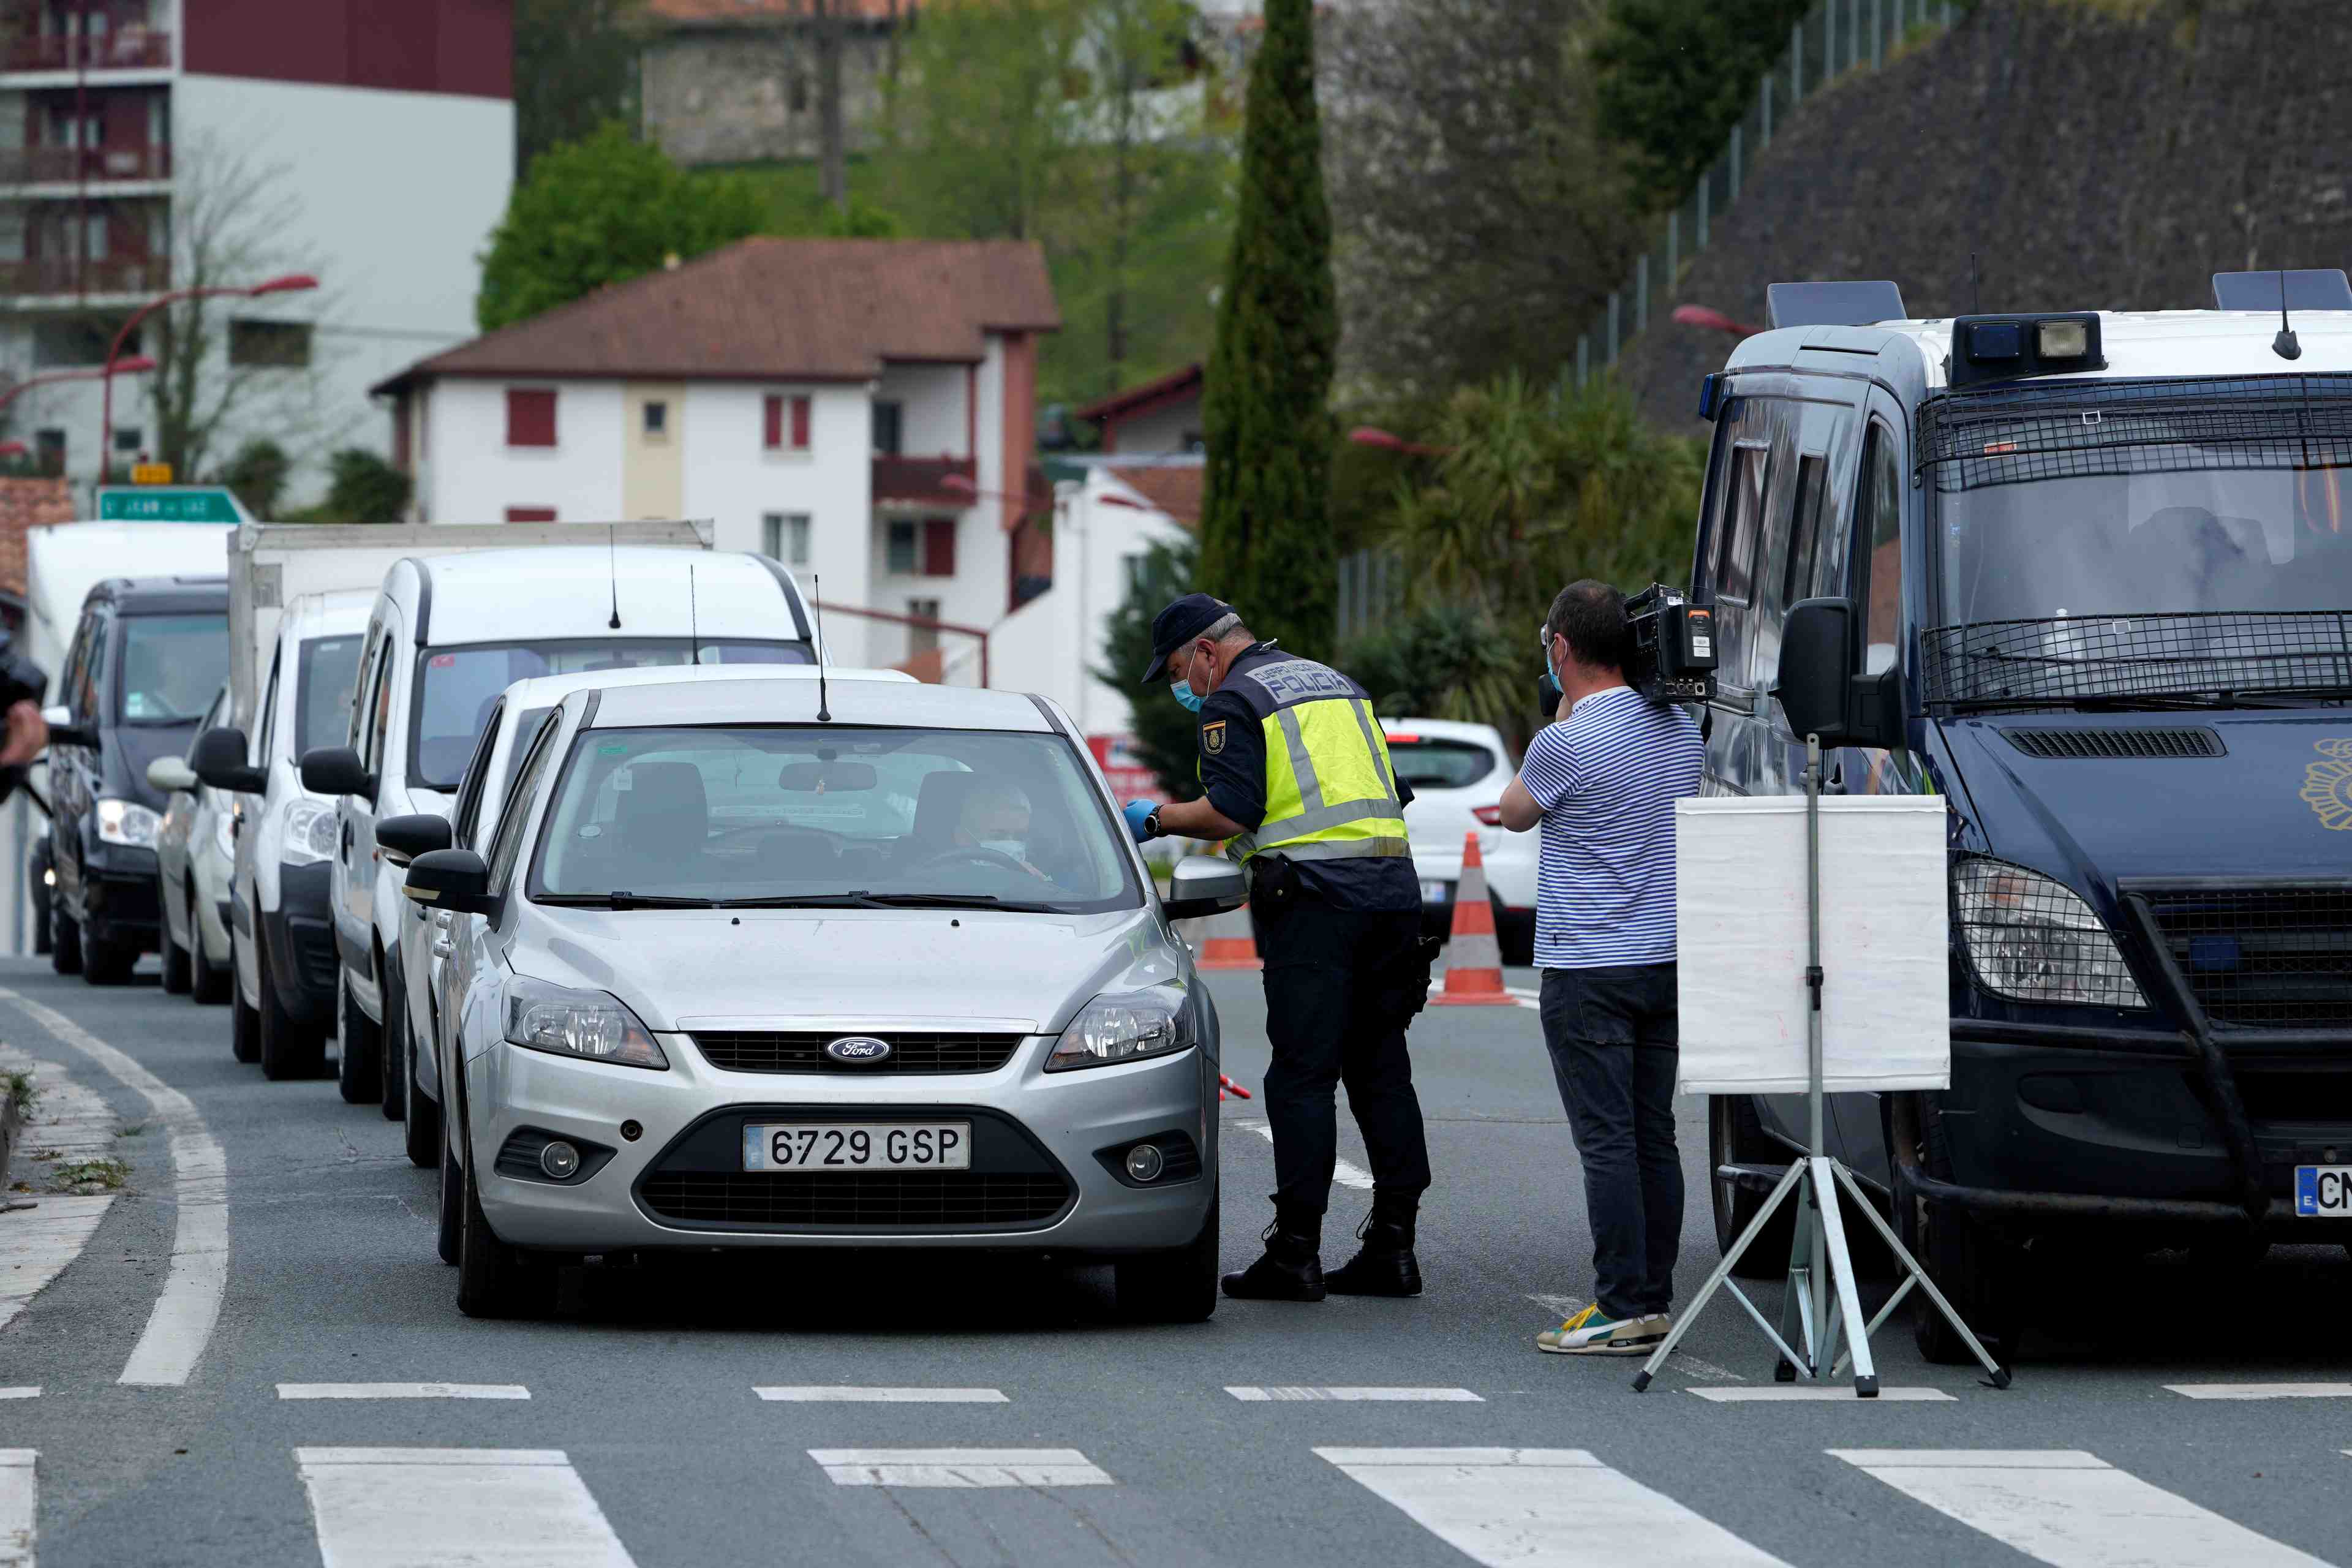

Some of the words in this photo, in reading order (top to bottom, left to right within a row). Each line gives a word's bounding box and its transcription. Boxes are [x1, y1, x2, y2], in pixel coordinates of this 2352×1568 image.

[1264, 673, 1350, 699] POLICIA
[842, 1041, 875, 1056] Ford
[771, 1130, 871, 1165] 6729
[886, 1129, 959, 1164] GSP
[2303, 1196, 2313, 1206] E
